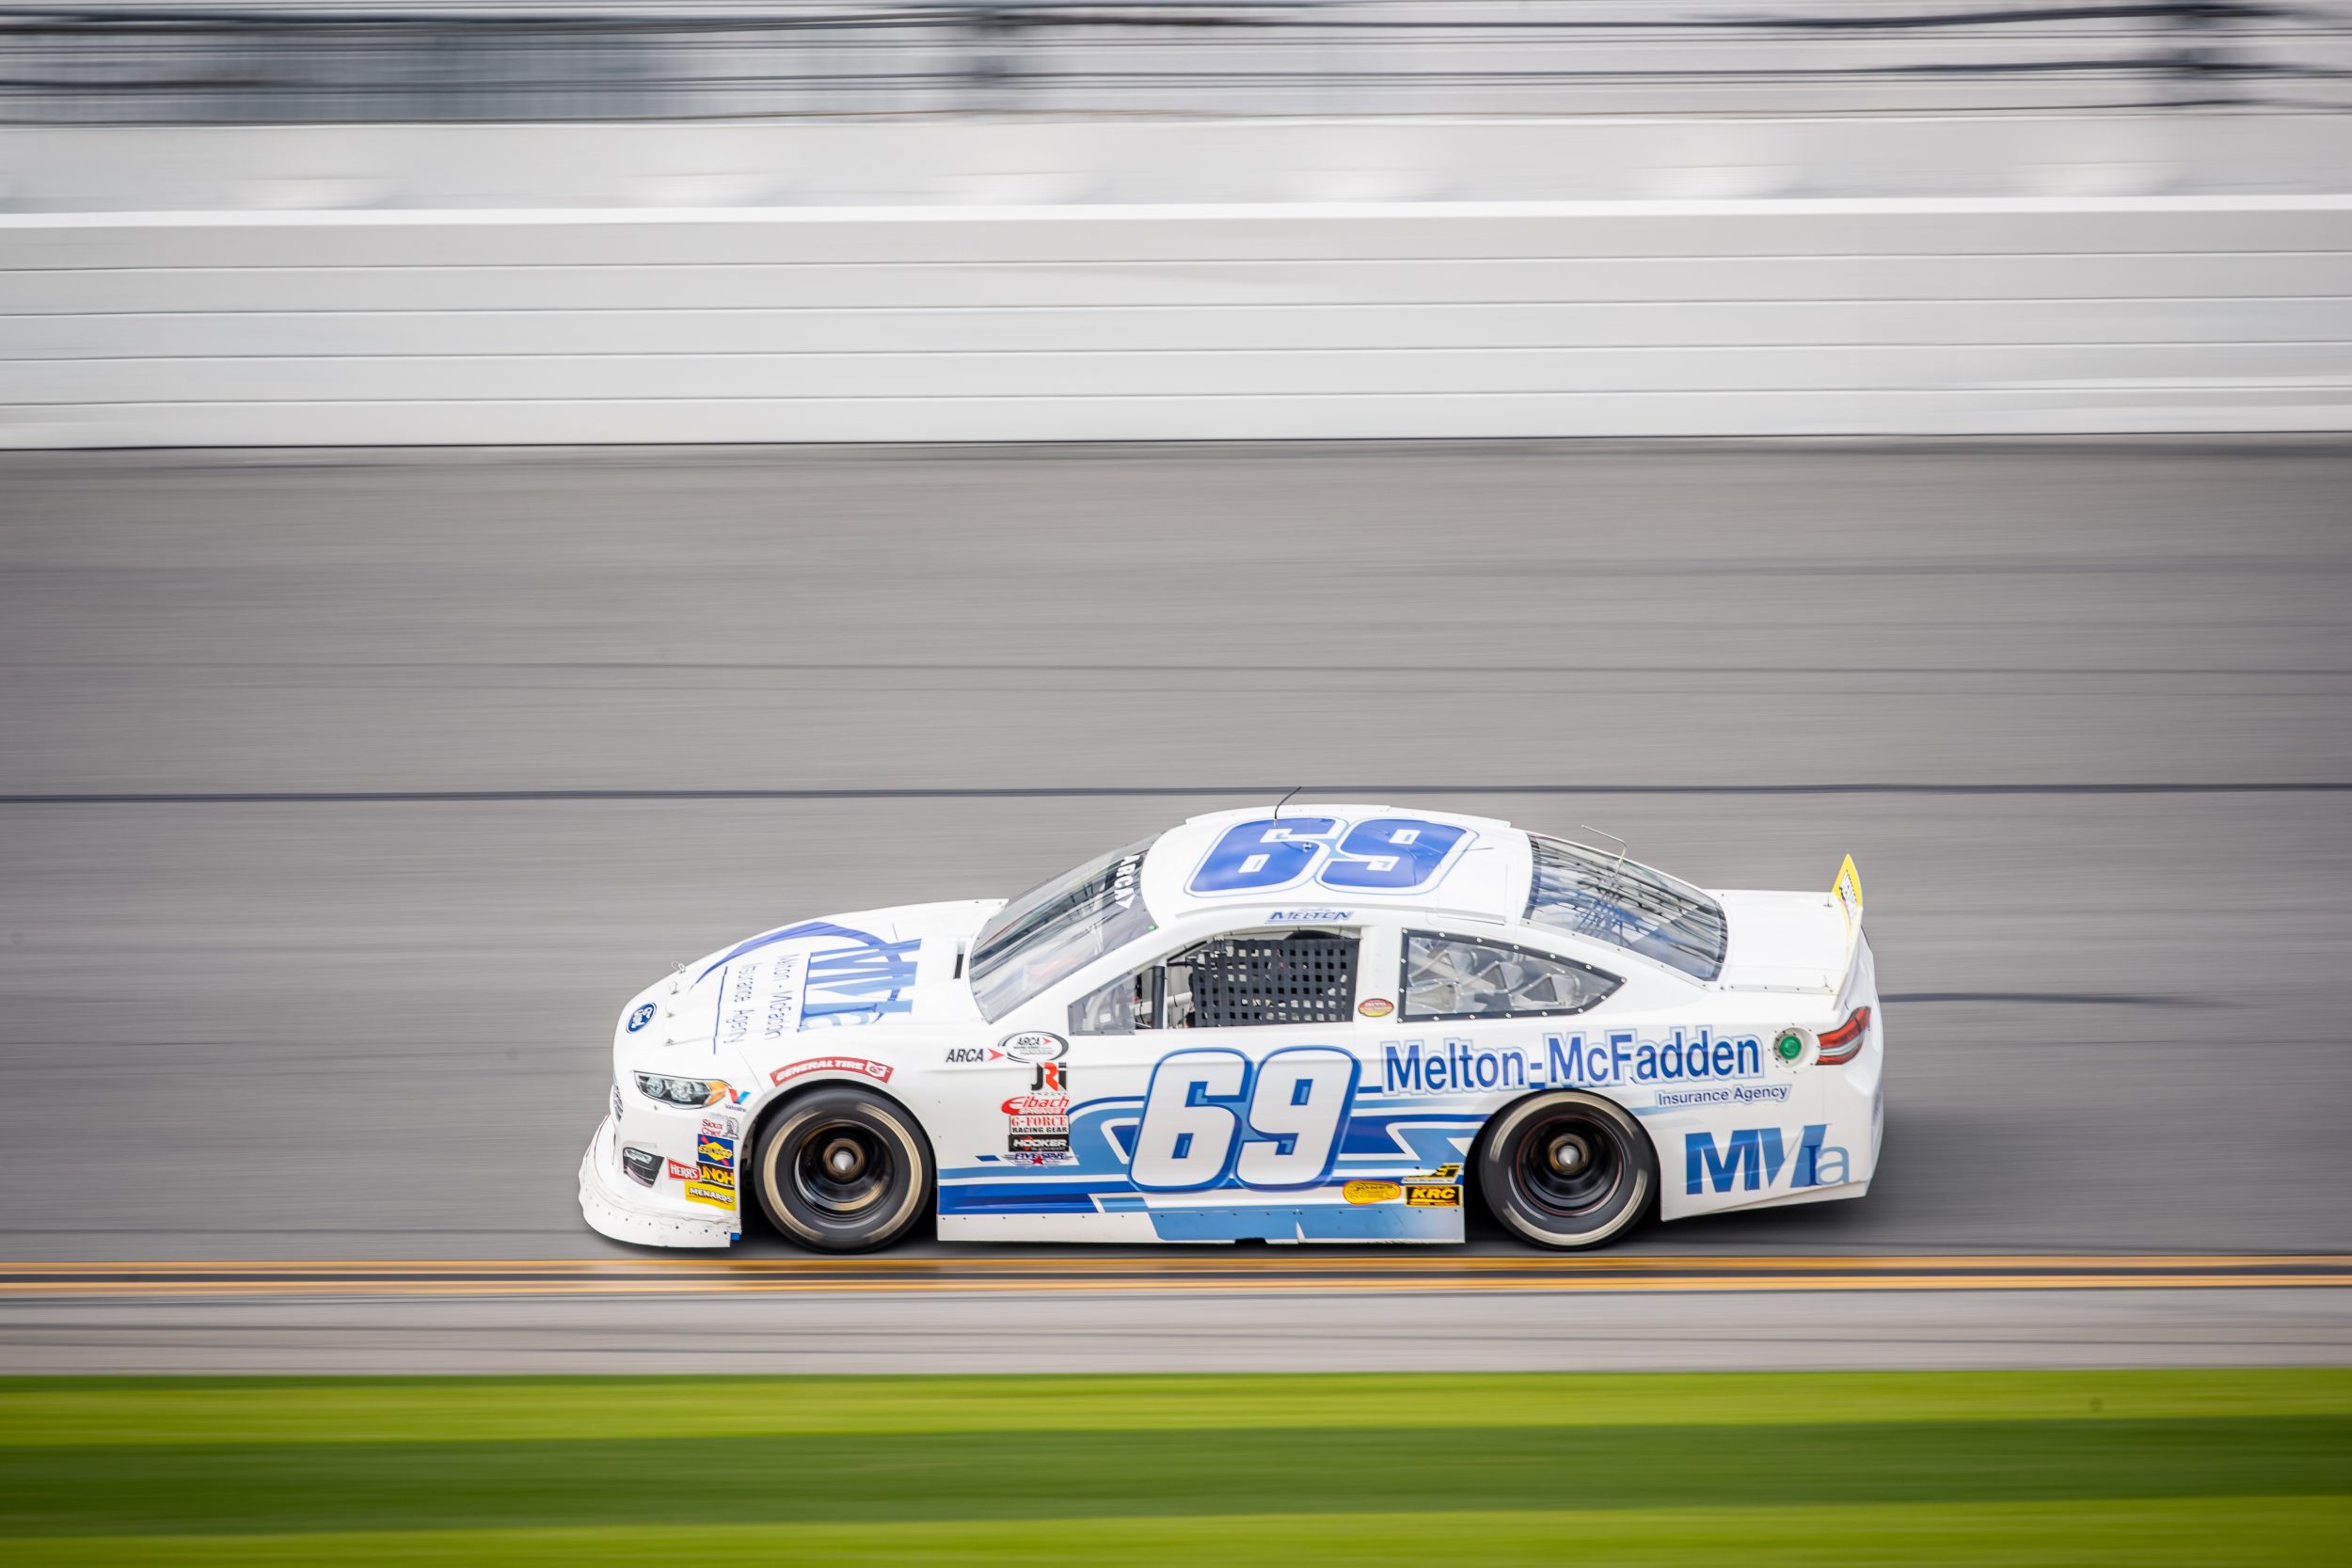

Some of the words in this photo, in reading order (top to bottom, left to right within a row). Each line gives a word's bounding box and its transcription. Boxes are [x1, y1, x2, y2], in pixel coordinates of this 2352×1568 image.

[1185, 816, 1473, 895] 69
[1114, 855, 1140, 900] ARCA
[946, 1048, 984, 1063] ARCA
[1385, 1029, 1760, 1092] Melton-McFadden
[776, 1059, 834, 1081] GENERAL
[834, 1059, 865, 1069] TIRE
[1659, 1090, 1729, 1105] Insurance
[1734, 1087, 1788, 1101] Agency
[1001, 1096, 1070, 1115] Eibach
[1011, 1117, 1067, 1127] G-FORCE
[1128, 1045, 1362, 1194] 69
[1013, 1139, 1068, 1148] HOOKER
[670, 1164, 699, 1180] HERR'S
[690, 1187, 735, 1203] MENARDS
[1412, 1188, 1456, 1199] KRC
